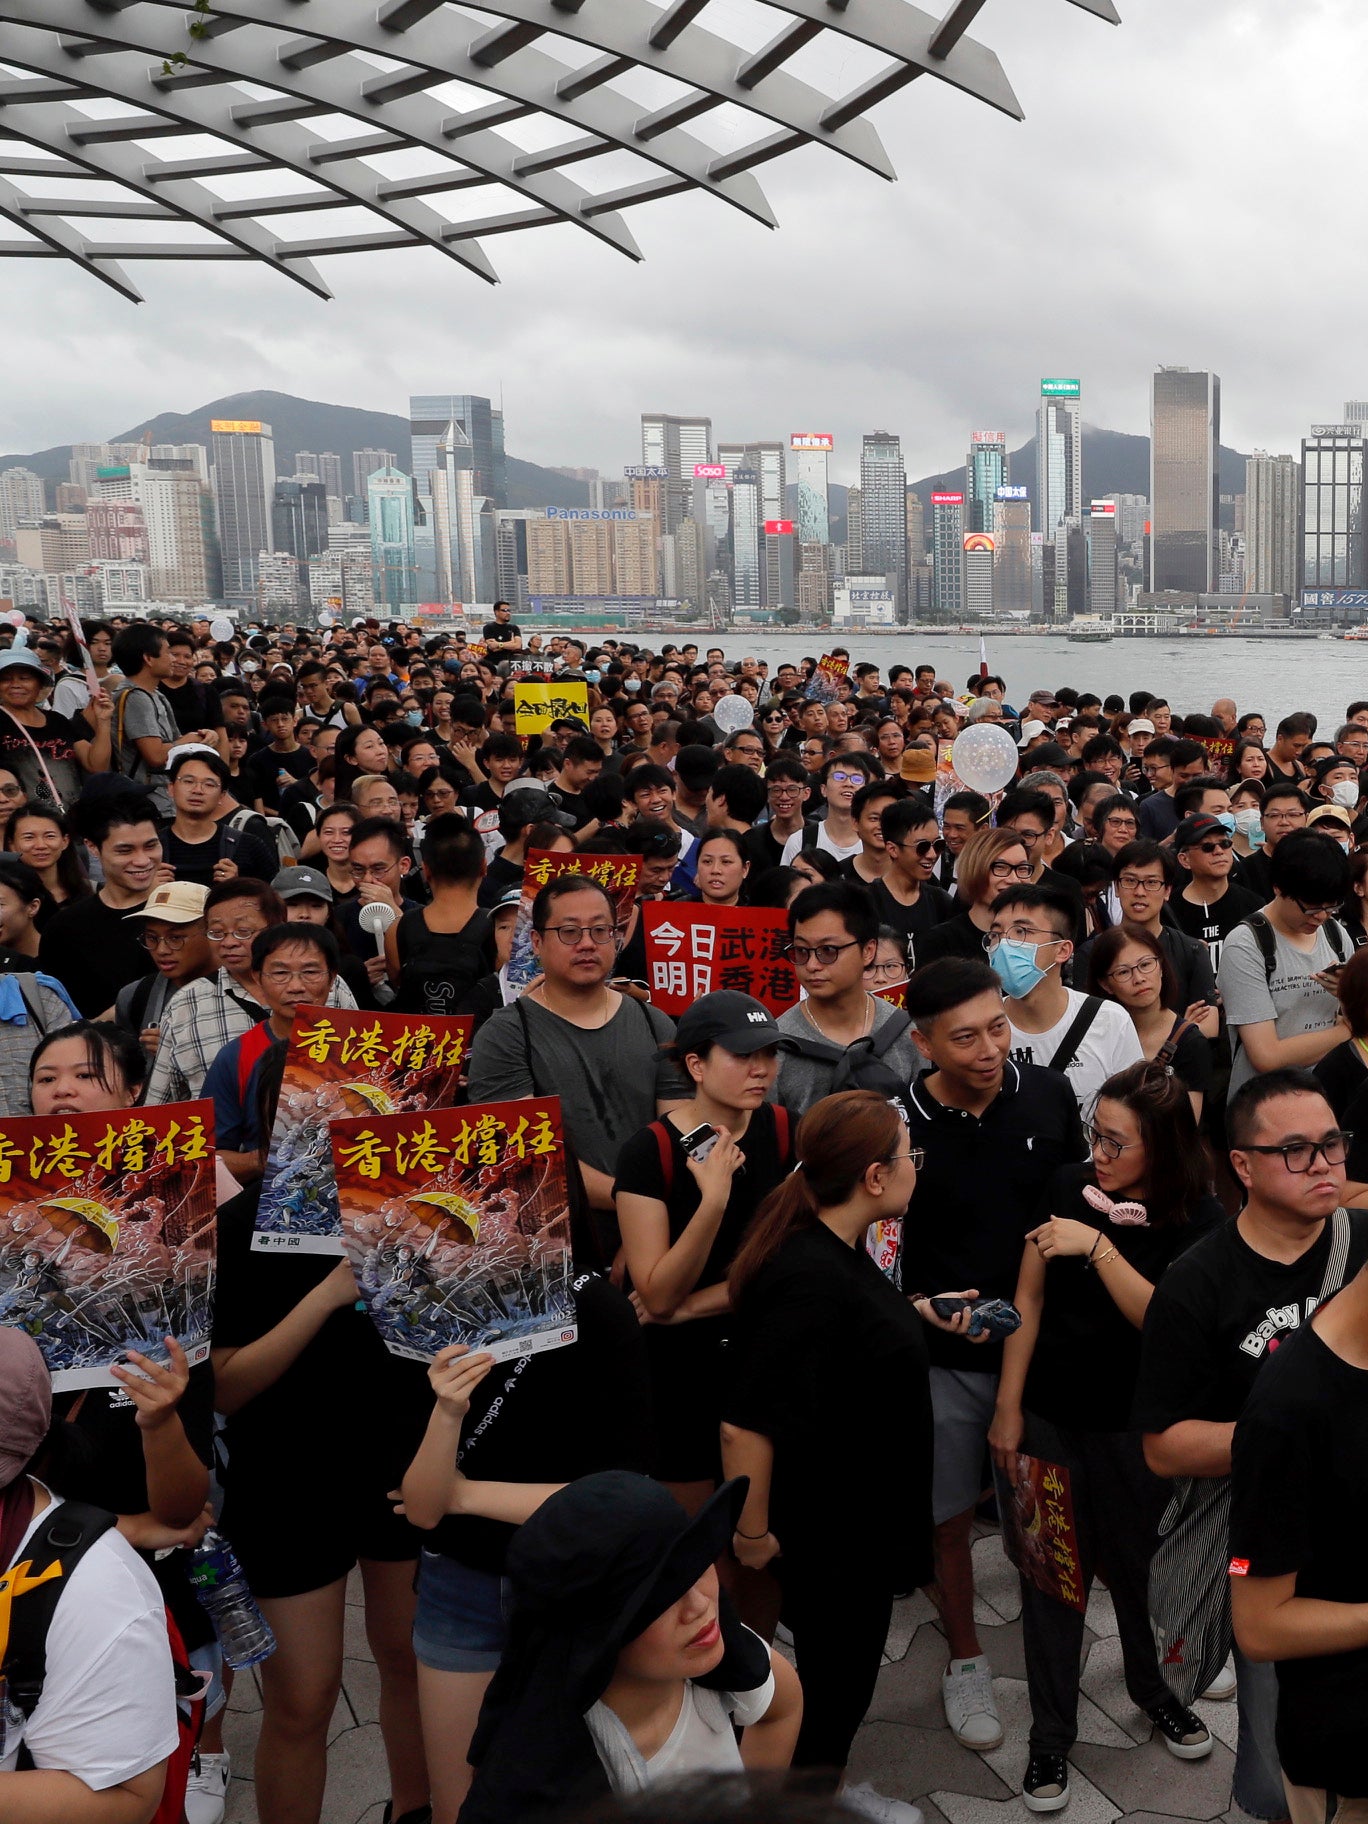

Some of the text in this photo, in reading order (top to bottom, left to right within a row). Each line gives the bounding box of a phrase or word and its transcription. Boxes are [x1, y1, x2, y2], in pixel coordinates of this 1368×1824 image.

[547, 506, 637, 520] Panasonic
[510, 660, 554, 673] 不撤不散
[1203, 925, 1219, 938] THE
[747, 1012, 768, 1023] HH
[297, 1019, 465, 1069] 香港撐住
[338, 1111, 558, 1179] 香港撐住
[551, 1310, 572, 1322] 002
[1239, 1303, 1300, 1358] Baby
[474, 1396, 504, 1435] adidas
